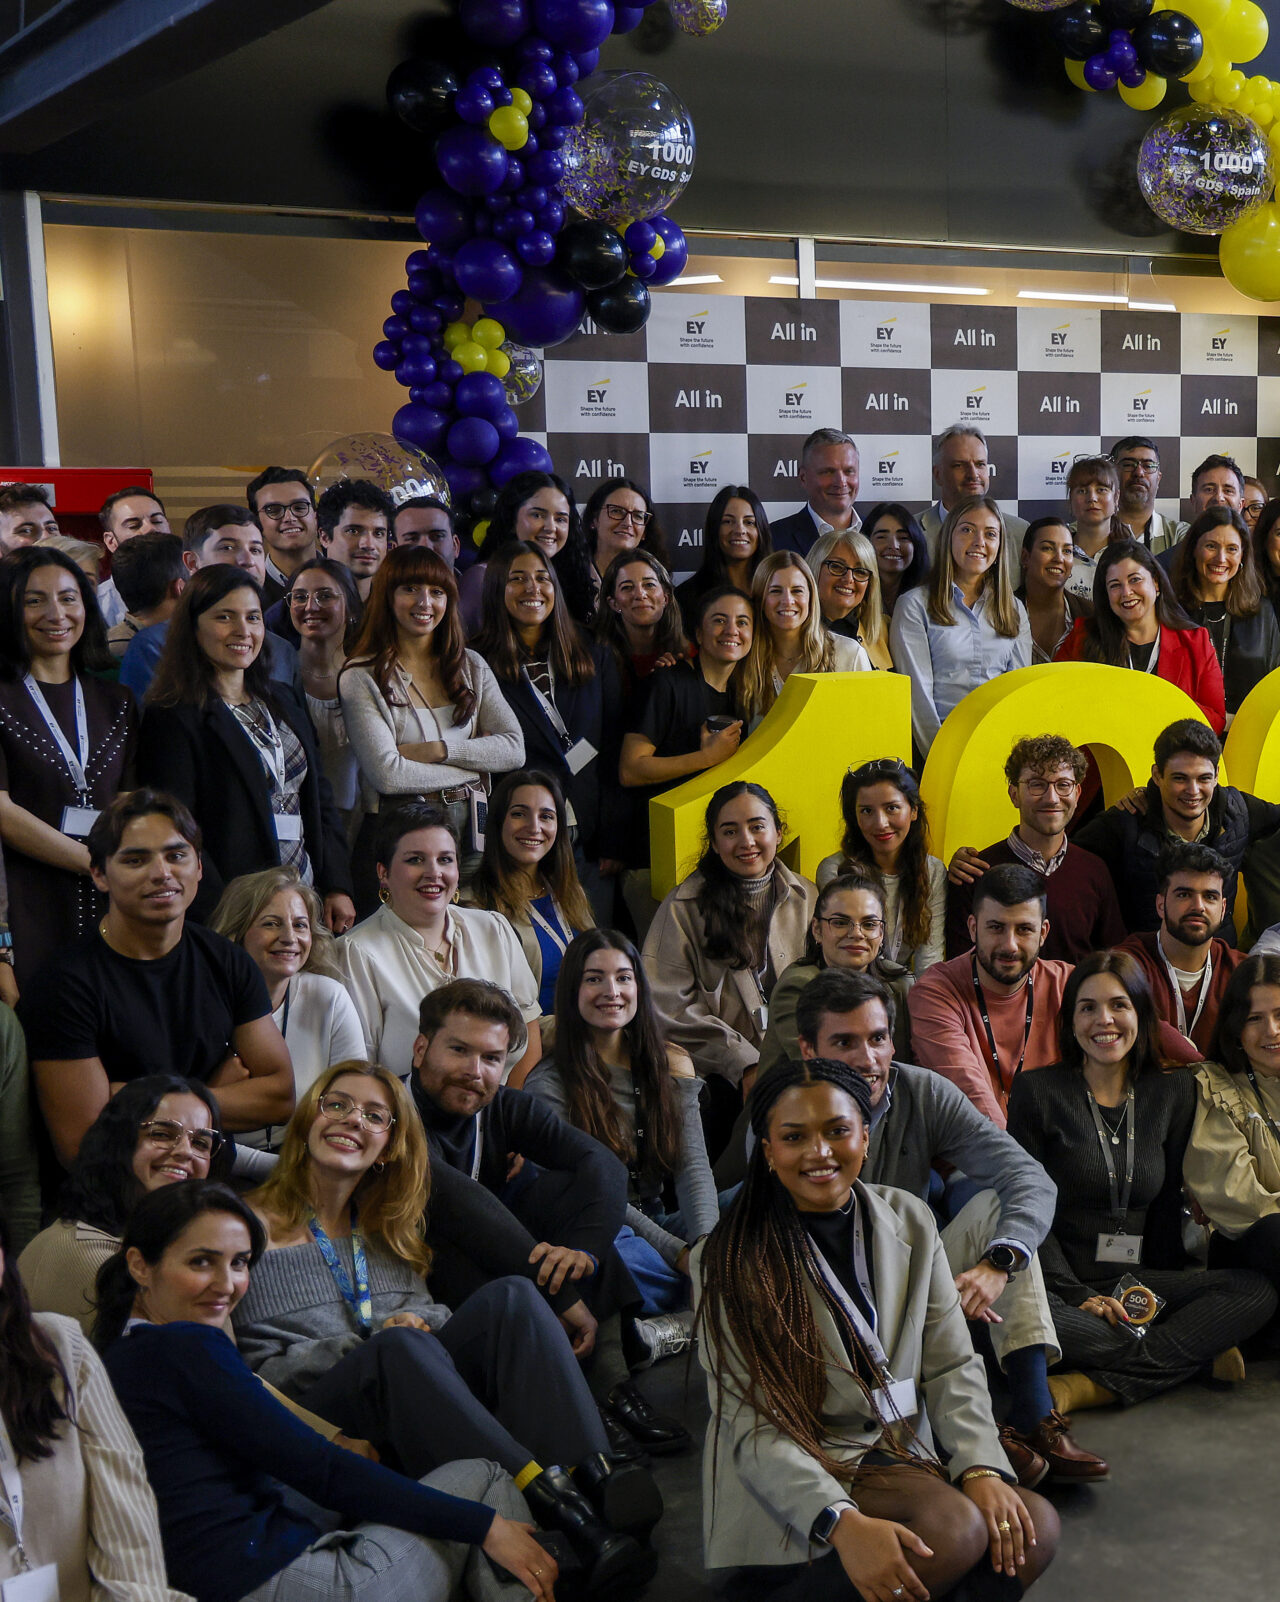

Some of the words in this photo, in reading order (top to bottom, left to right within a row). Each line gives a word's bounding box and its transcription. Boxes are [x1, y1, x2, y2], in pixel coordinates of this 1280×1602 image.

[649, 140, 692, 165] 1000
[628, 160, 650, 175] EY
[651, 167, 676, 182] GDS
[1200, 152, 1253, 174] 1000
[1196, 177, 1224, 192] GDS
[1230, 184, 1260, 197] Spain
[686, 321, 705, 334] EY
[771, 323, 795, 340] All
[801, 323, 817, 340] in
[876, 328, 894, 340] EY
[954, 329, 976, 346] All
[980, 329, 995, 346] in
[1051, 333, 1067, 345] EY
[1122, 334, 1142, 350] All
[1147, 334, 1161, 350] in
[1212, 338, 1227, 349] EY
[587, 390, 607, 403] EY
[675, 390, 699, 408] All
[706, 390, 722, 408] in
[785, 393, 804, 406] EY
[866, 393, 888, 410] All
[894, 393, 909, 410] in
[966, 396, 983, 408] EY
[1040, 396, 1061, 412] All
[1066, 396, 1080, 412] in
[1133, 399, 1149, 410] EY
[1201, 398, 1221, 414] All
[1225, 398, 1238, 414] in
[575, 460, 600, 478] All
[607, 459, 625, 478] in
[690, 461, 709, 474] EY
[774, 460, 798, 477] All
[878, 462, 896, 474] EY
[987, 463, 996, 476] n
[1051, 461, 1067, 473] EY
[678, 529, 703, 546] All
[1129, 1294, 1148, 1305] 500
